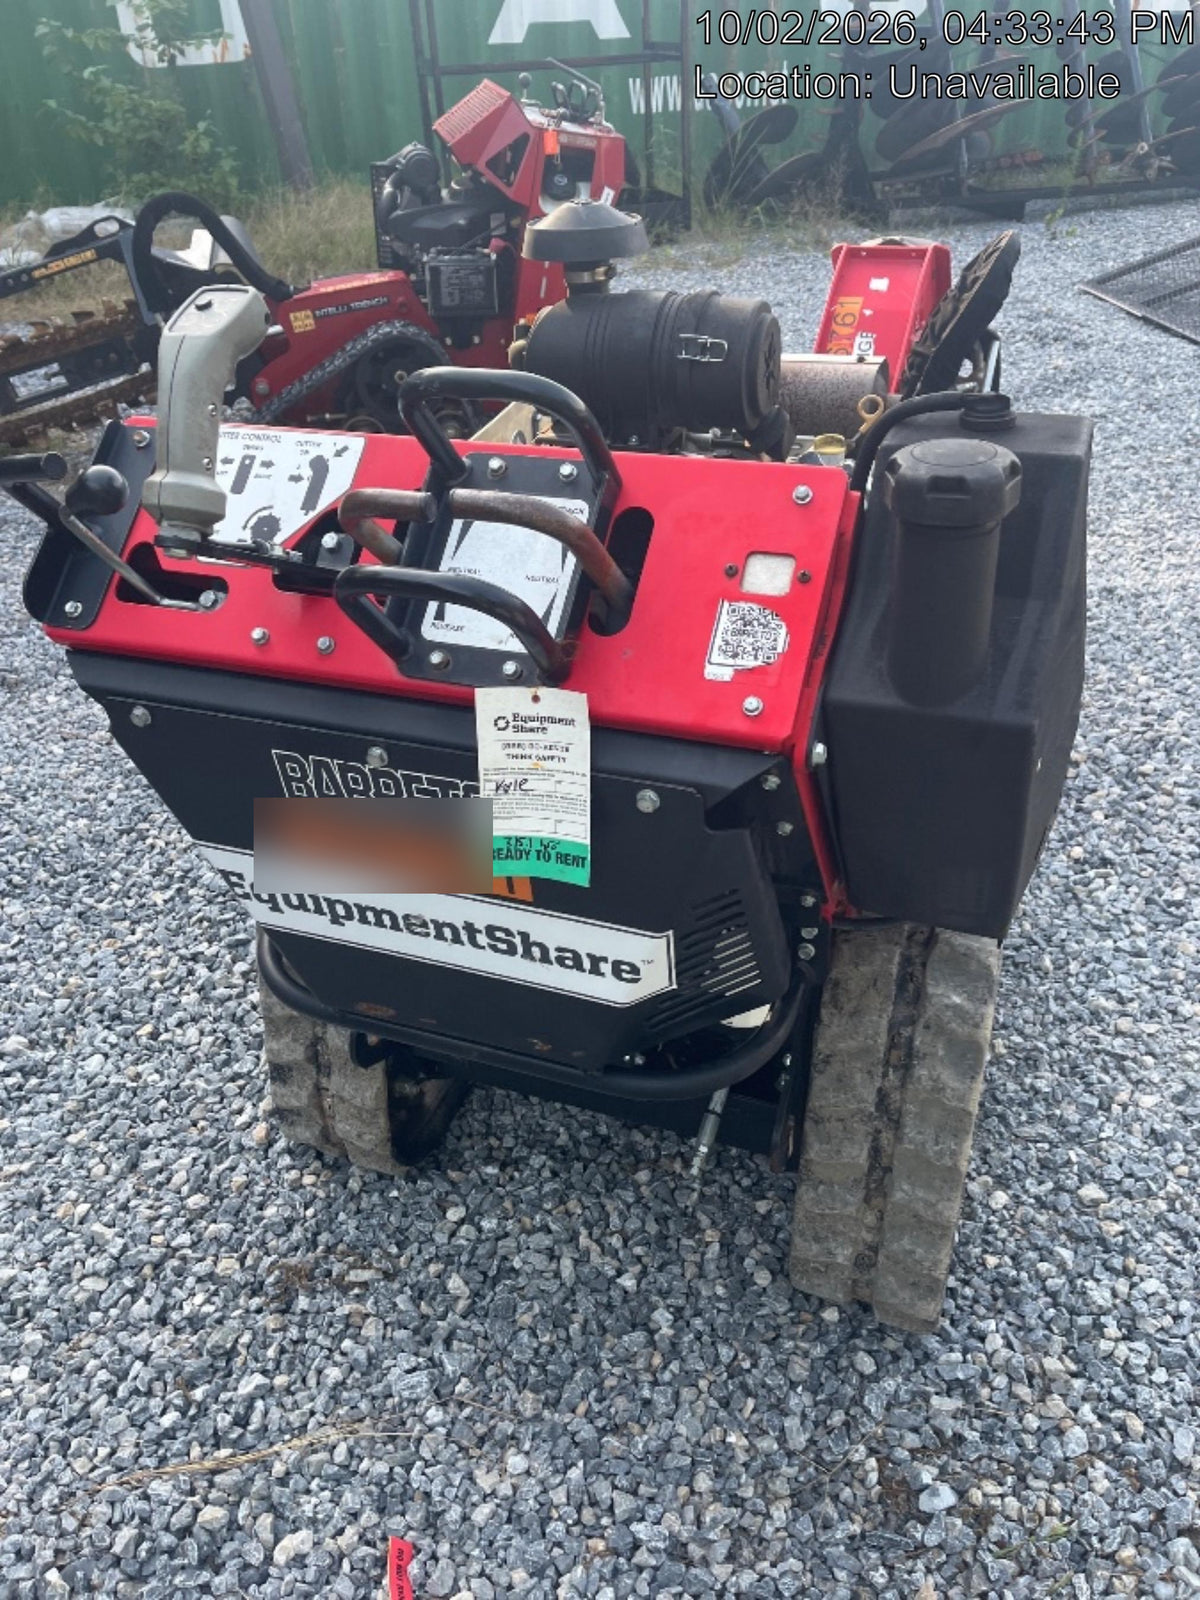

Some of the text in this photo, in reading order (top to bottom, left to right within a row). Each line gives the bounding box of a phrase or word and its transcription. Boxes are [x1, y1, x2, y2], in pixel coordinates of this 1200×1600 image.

[511, 712, 576, 727] Equipment
[511, 724, 548, 735] Share
[505, 753, 567, 763] THINK SAFETY
[493, 848, 588, 869] EADY TO RENT
